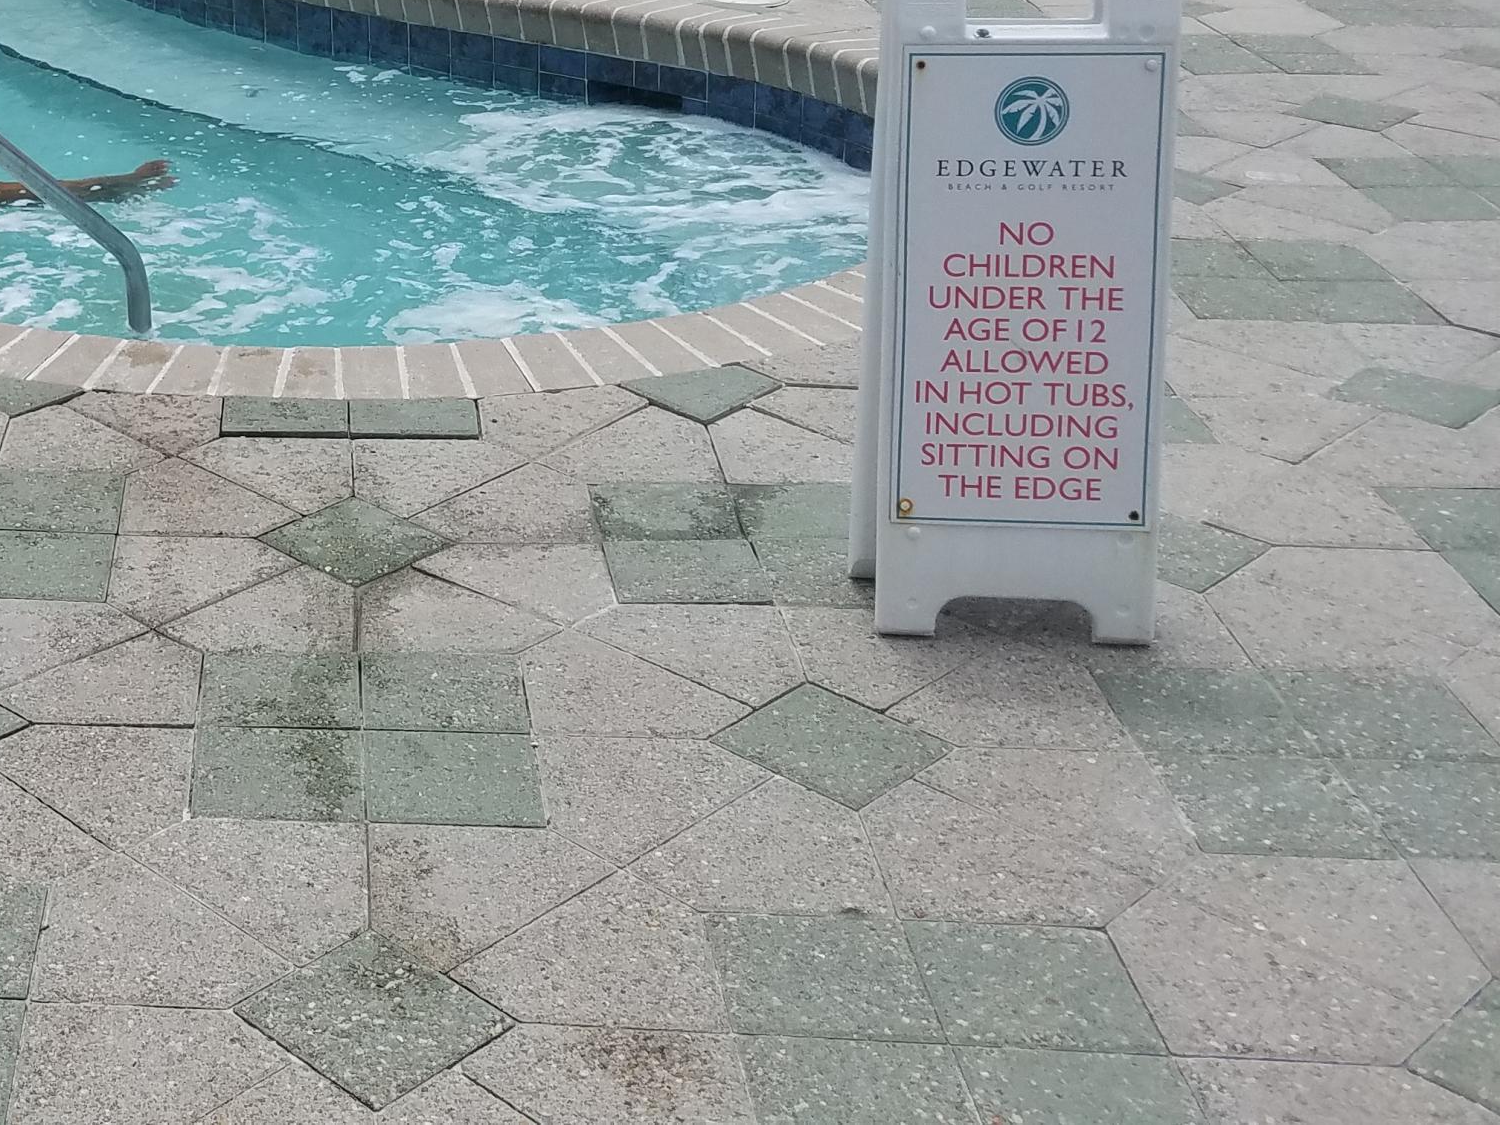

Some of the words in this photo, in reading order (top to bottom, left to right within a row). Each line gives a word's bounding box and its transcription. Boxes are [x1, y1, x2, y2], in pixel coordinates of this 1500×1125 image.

[936, 159, 1128, 178] EDGEWATER
[948, 183, 993, 191] BEACH
[1001, 183, 1008, 191] &
[1017, 183, 1053, 192] GOLF
[1062, 184, 1116, 192] RESORT
[999, 222, 1054, 246] NO
[943, 254, 1115, 278] CHILDREN
[929, 286, 1046, 310] UNDER
[1058, 287, 1124, 311] THE
[944, 318, 1010, 341] AGE
[1022, 318, 1067, 342] OF
[1077, 319, 1106, 343] 12
[940, 349, 1109, 374] ALLOWED
[915, 380, 948, 404] IN
[959, 381, 1032, 405] HOT
[1044, 382, 1134, 411] TUBS,
[926, 412, 1118, 439] INCLUDING
[921, 443, 1051, 469] SITTING
[1064, 446, 1119, 470] ON
[938, 474, 1002, 499] THE
[1014, 477, 1102, 501] EDGE
